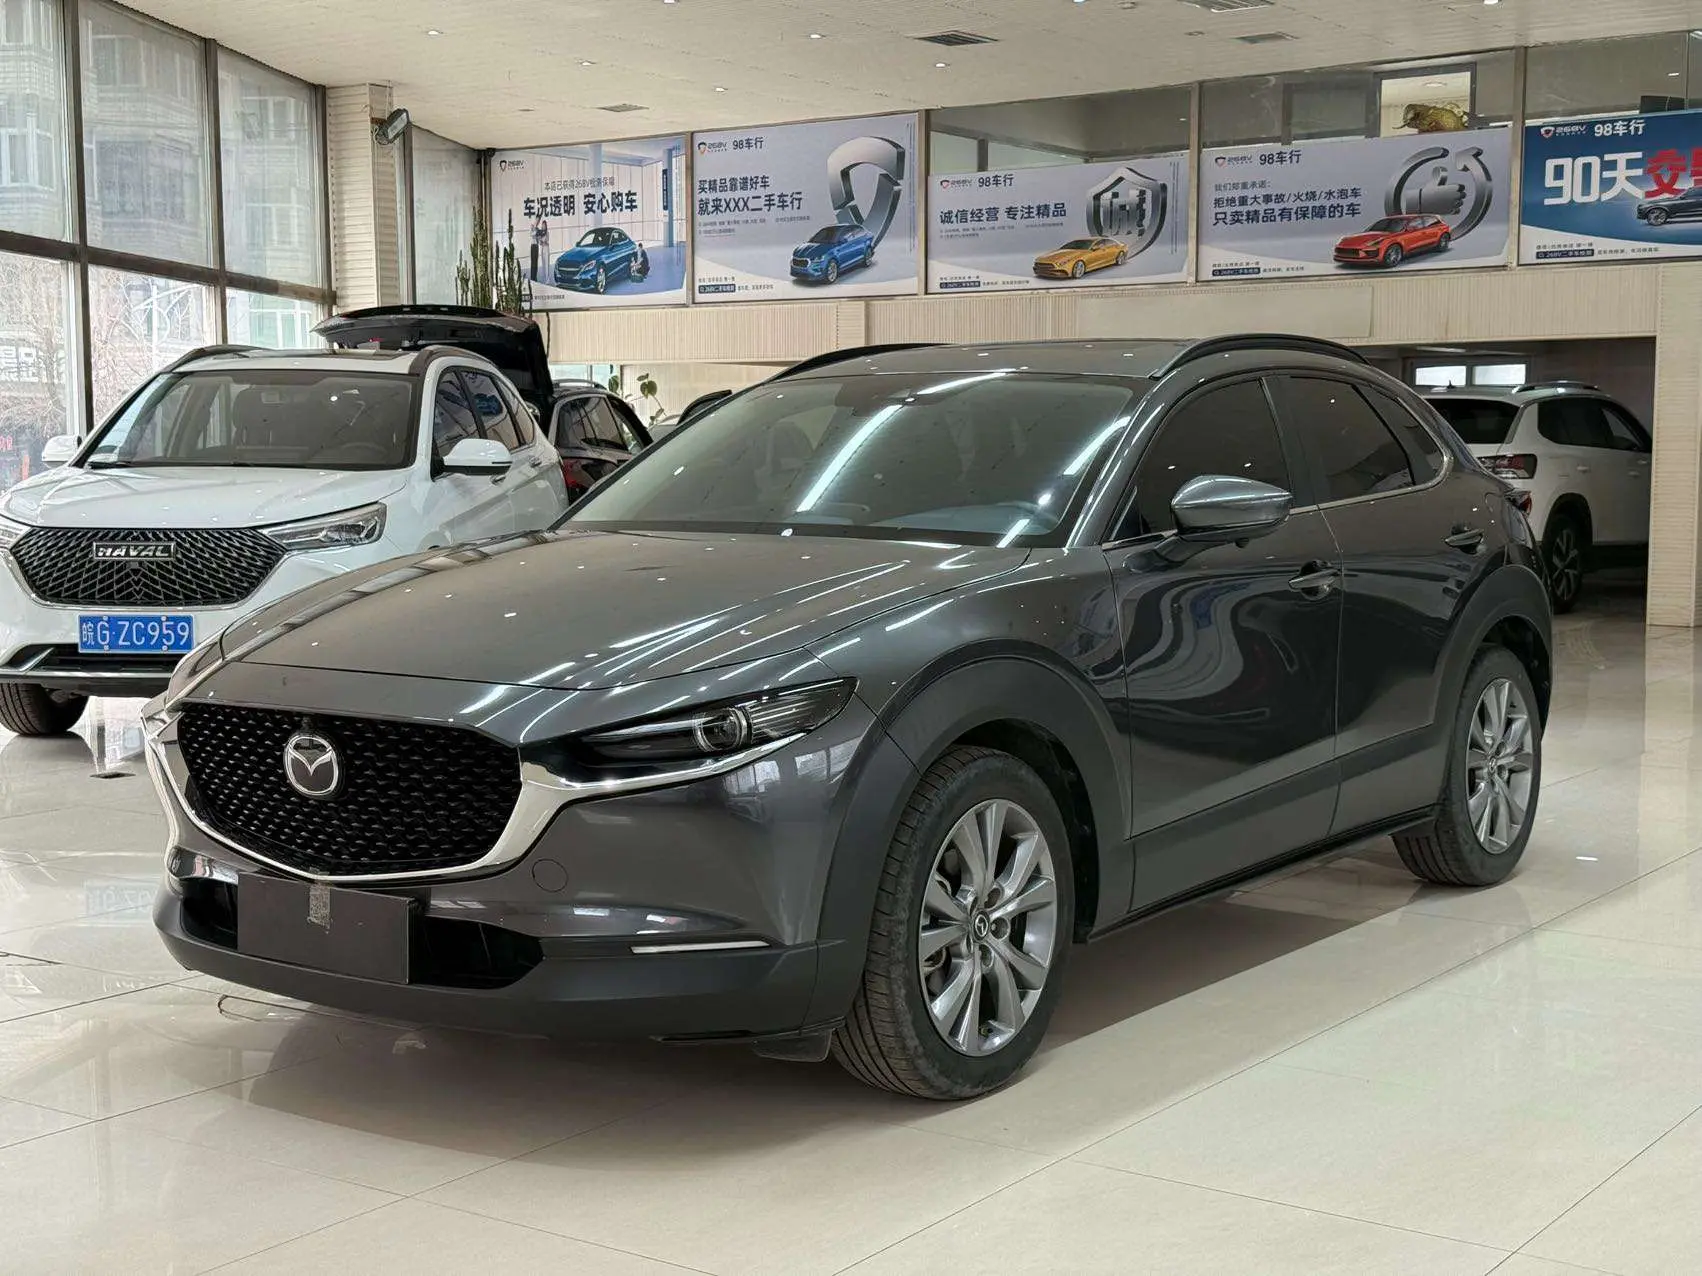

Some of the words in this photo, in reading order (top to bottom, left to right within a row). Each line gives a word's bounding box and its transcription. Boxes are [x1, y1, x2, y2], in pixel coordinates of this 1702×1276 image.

[1594, 119, 1646, 137] 98车行
[732, 137, 764, 150] 98车行
[1259, 149, 1302, 165] 98车行
[698, 175, 770, 194] 买精品靠谱好车
[978, 173, 1015, 187] 98车行
[1544, 148, 1702, 205] 90天交
[523, 194, 576, 219] 车况透明
[583, 190, 638, 215] 安心购车
[697, 191, 803, 216] 就来XXX二手车行
[1213, 187, 1362, 209] 拒绝重大事故/火烧/水泡车
[940, 206, 999, 225] 诚信经营
[1004, 202, 1067, 221] 专注精品
[1213, 202, 1362, 226] 只卖精品有保障的车
[98, 545, 170, 557] HAVAL
